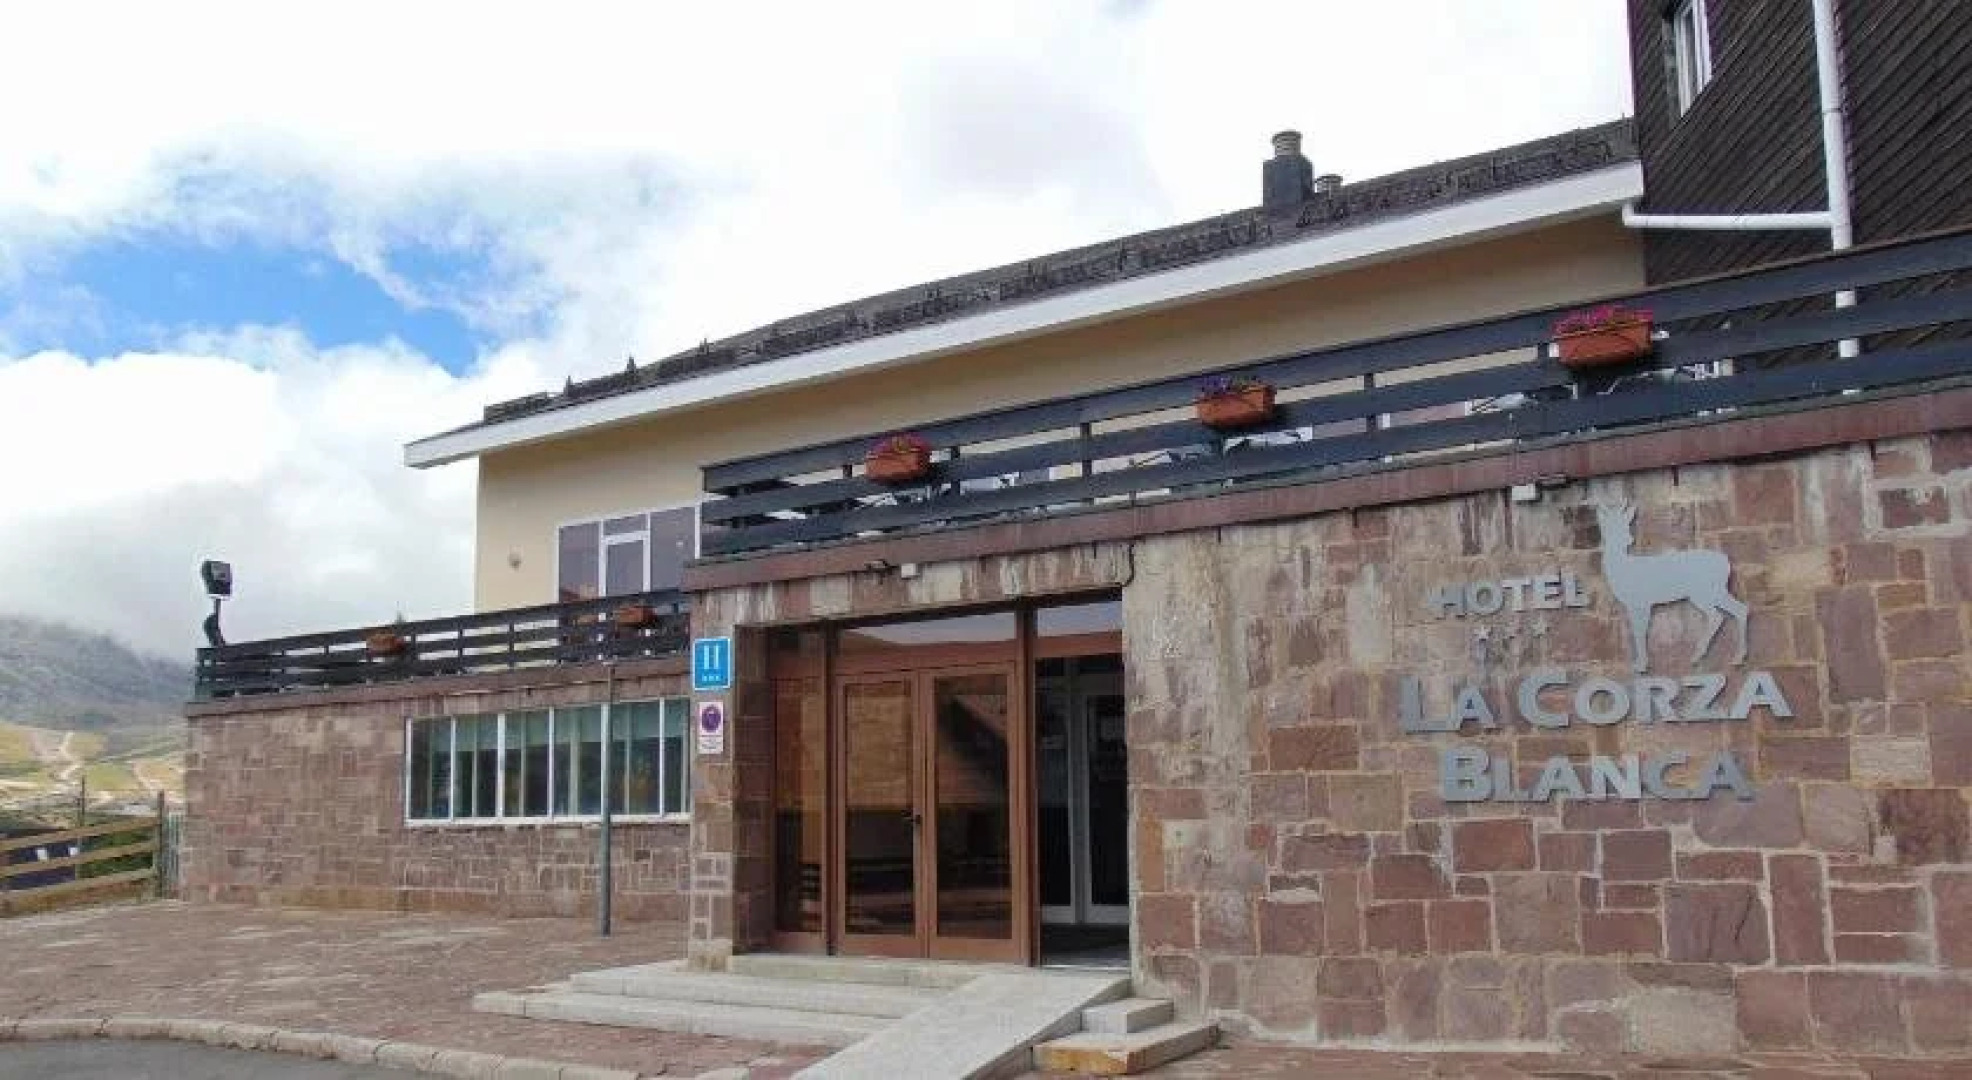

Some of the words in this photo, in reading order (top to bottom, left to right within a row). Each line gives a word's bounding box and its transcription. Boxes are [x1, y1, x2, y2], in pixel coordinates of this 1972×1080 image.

[1428, 572, 1590, 617] HOTEL
[1399, 674, 1498, 732] LA
[1518, 668, 1793, 728] CORZA
[1442, 745, 1754, 802] BLANCA
